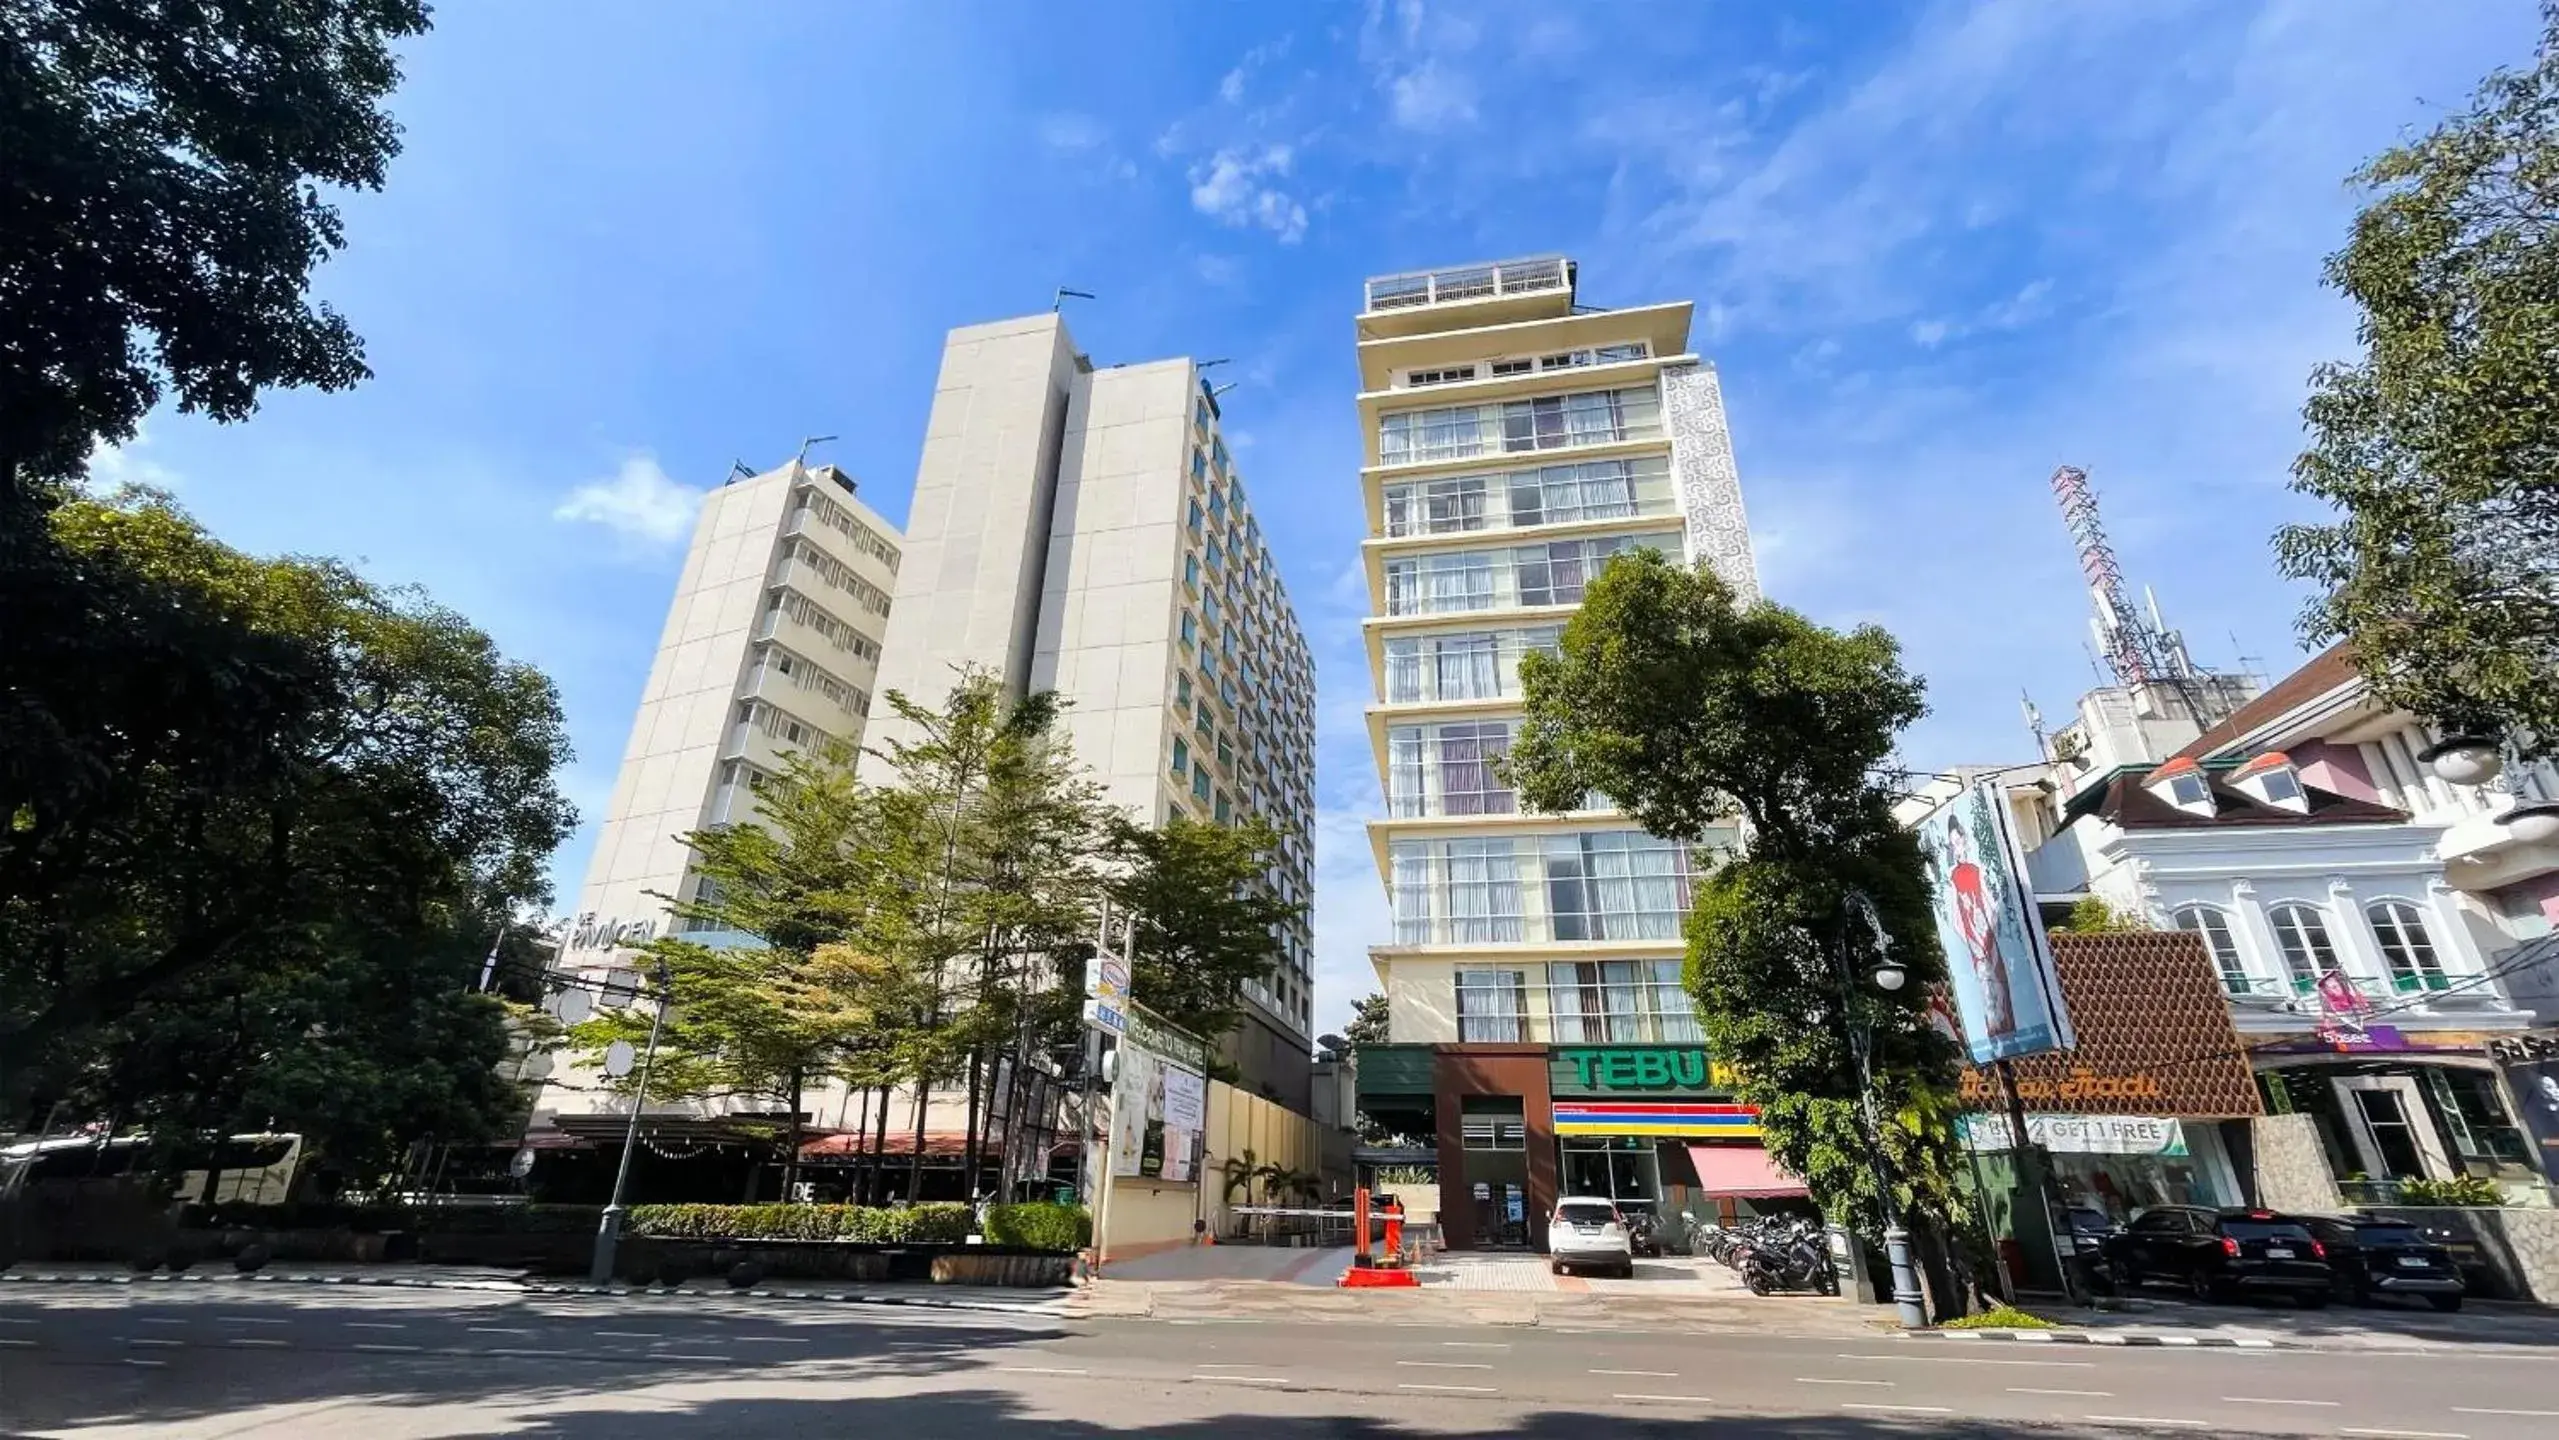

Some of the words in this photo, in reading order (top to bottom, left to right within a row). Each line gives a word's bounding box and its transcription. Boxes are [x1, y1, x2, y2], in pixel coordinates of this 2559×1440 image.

[1569, 1050, 1705, 1086] TEBU
[2052, 1122, 2090, 1138] GET
[2096, 1122, 2106, 1138] 1
[2111, 1122, 2161, 1139] FREE
[791, 1182, 816, 1202] DE
